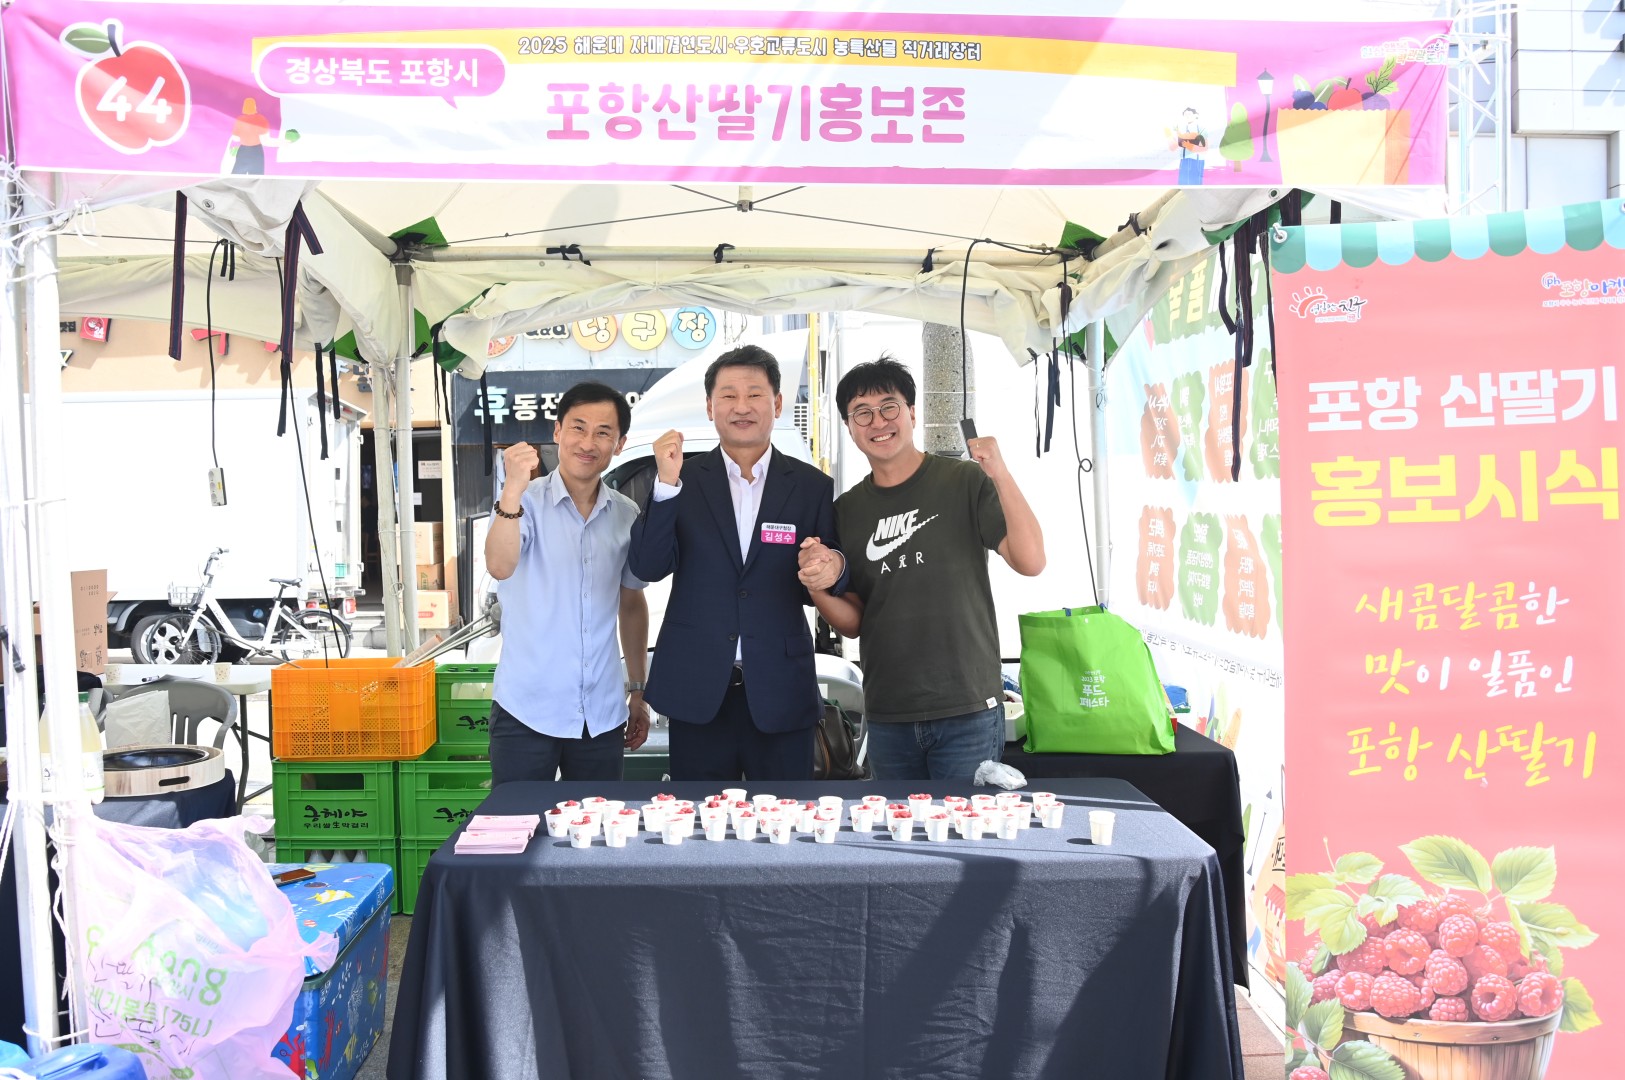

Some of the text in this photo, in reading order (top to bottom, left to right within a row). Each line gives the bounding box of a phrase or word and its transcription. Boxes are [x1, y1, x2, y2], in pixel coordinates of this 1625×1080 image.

[518, 35, 982, 62] 2025 해운대 자매결연도시·우호교류도시 농특산물 직거래장터
[285, 57, 480, 88] 경상북도 포항시
[96, 75, 173, 125] 44
[545, 82, 966, 144] 포항산딸기홍보존
[1338, 295, 1368, 319] 친구
[577, 311, 709, 343] 당구장
[1308, 377, 1422, 432] 포항
[1440, 366, 1617, 428] 산딸기
[1311, 447, 1619, 527] 홍보시식
[765, 532, 792, 543] 김성수
[874, 508, 919, 541] NIKE
[1354, 581, 1570, 631] 새콤달콤한
[1365, 647, 1573, 698] 맛이 일품인
[1079, 696, 1110, 708] 페스타
[1082, 684, 1106, 696] 푸드
[1347, 721, 1596, 787] 포항 산딸기
